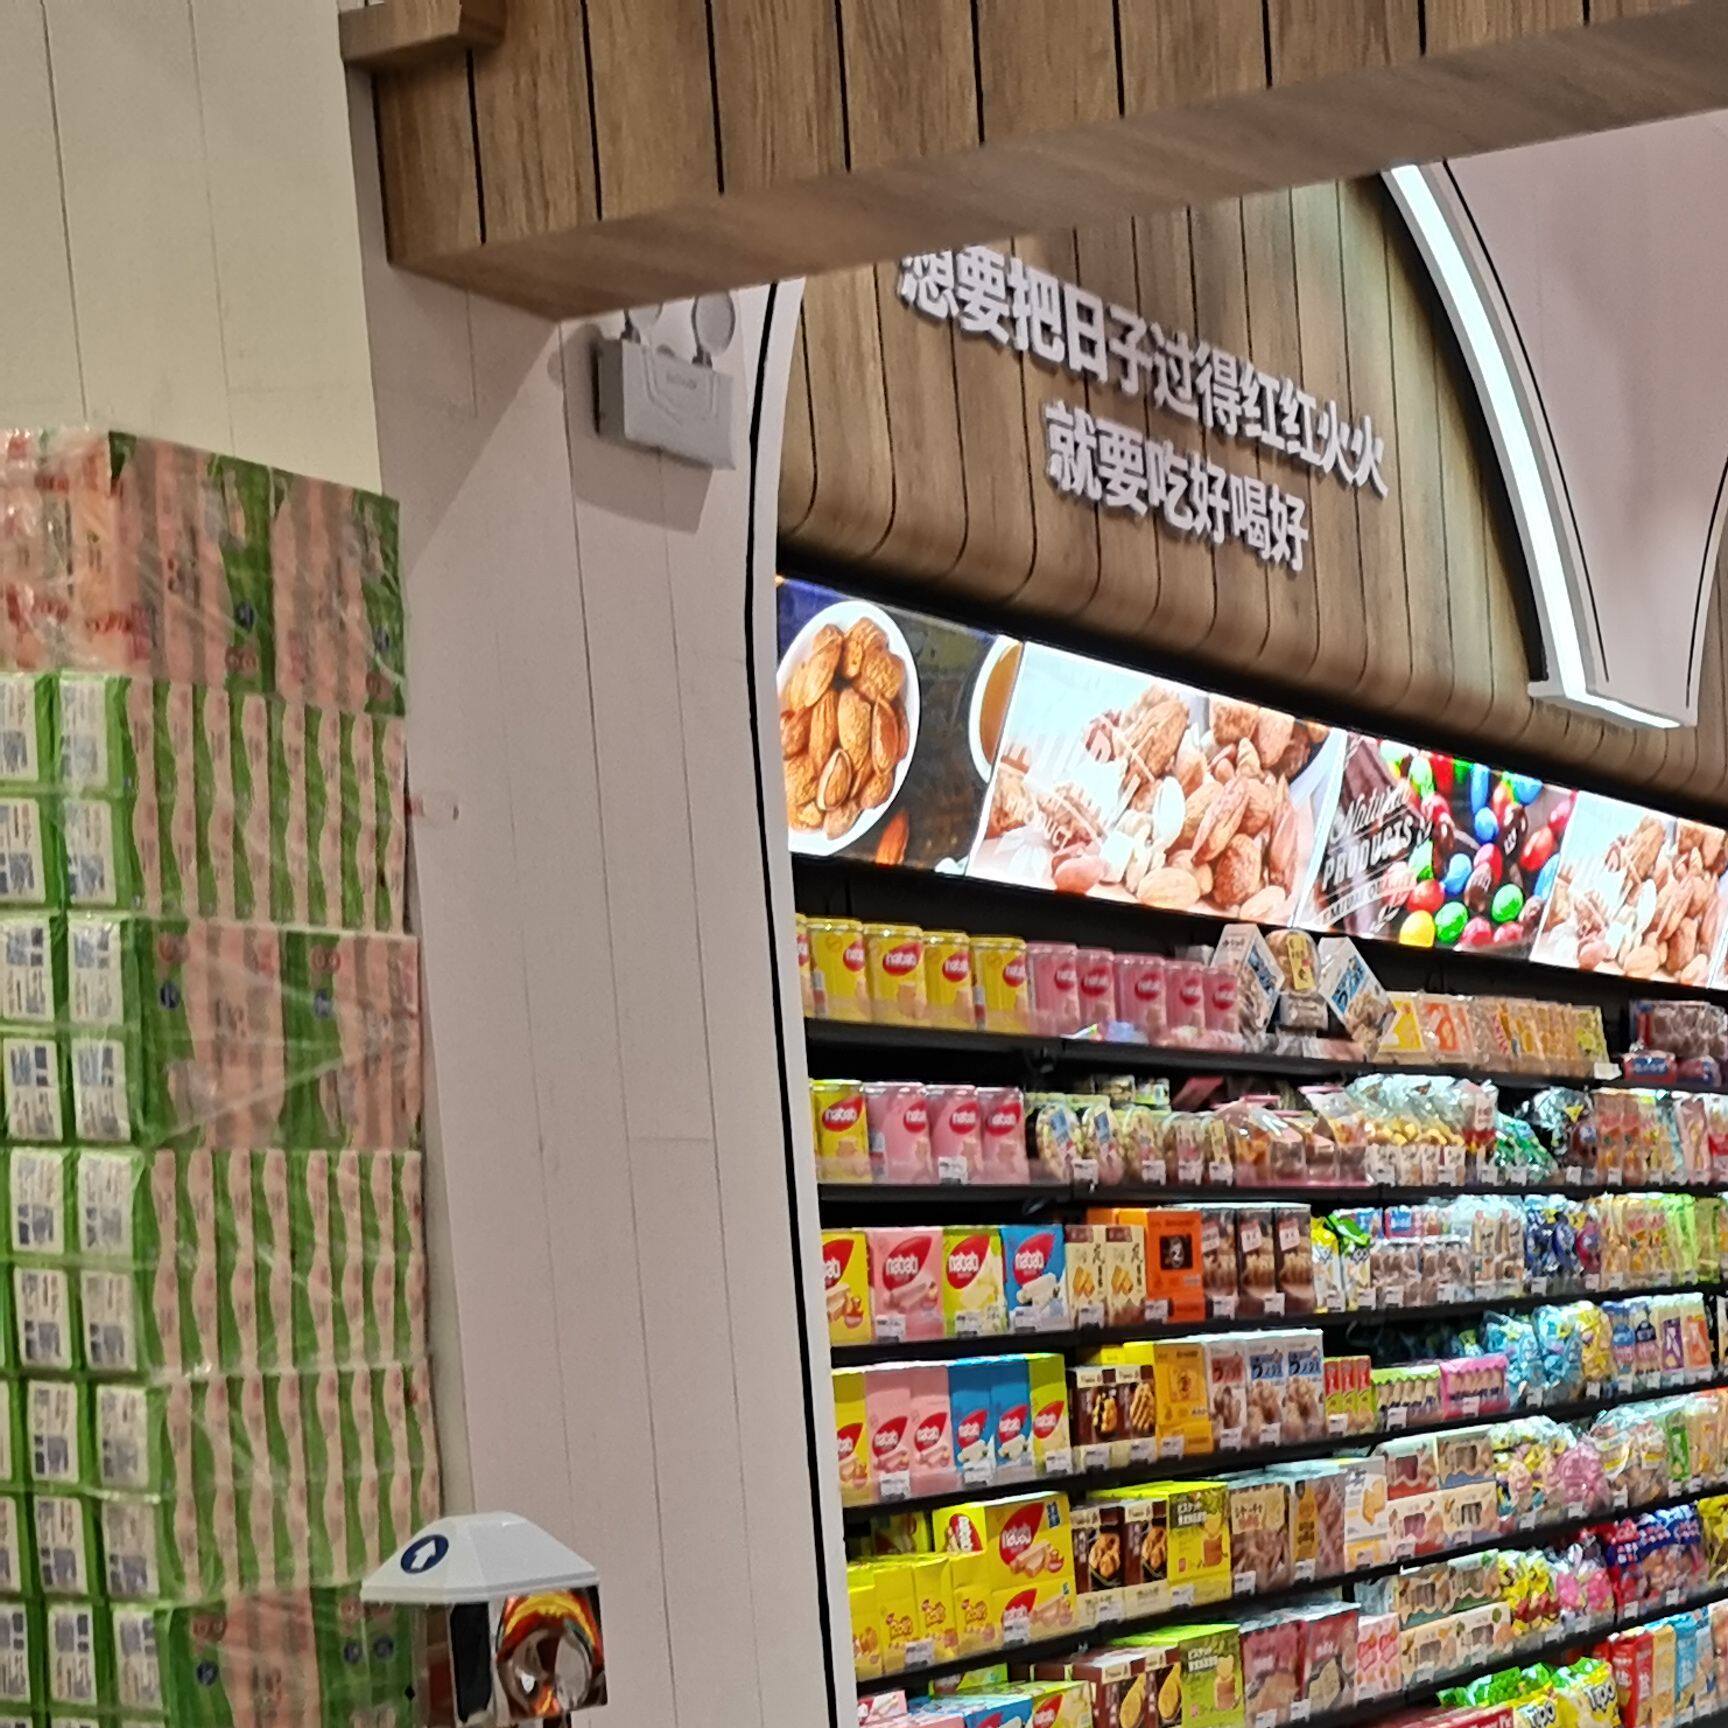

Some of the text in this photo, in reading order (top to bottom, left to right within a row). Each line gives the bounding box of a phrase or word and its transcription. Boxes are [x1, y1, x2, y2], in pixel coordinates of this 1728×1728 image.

[898, 245, 1389, 499] 想要把日子过得红红火火
[1044, 400, 1310, 572] 就要吃好喝好
